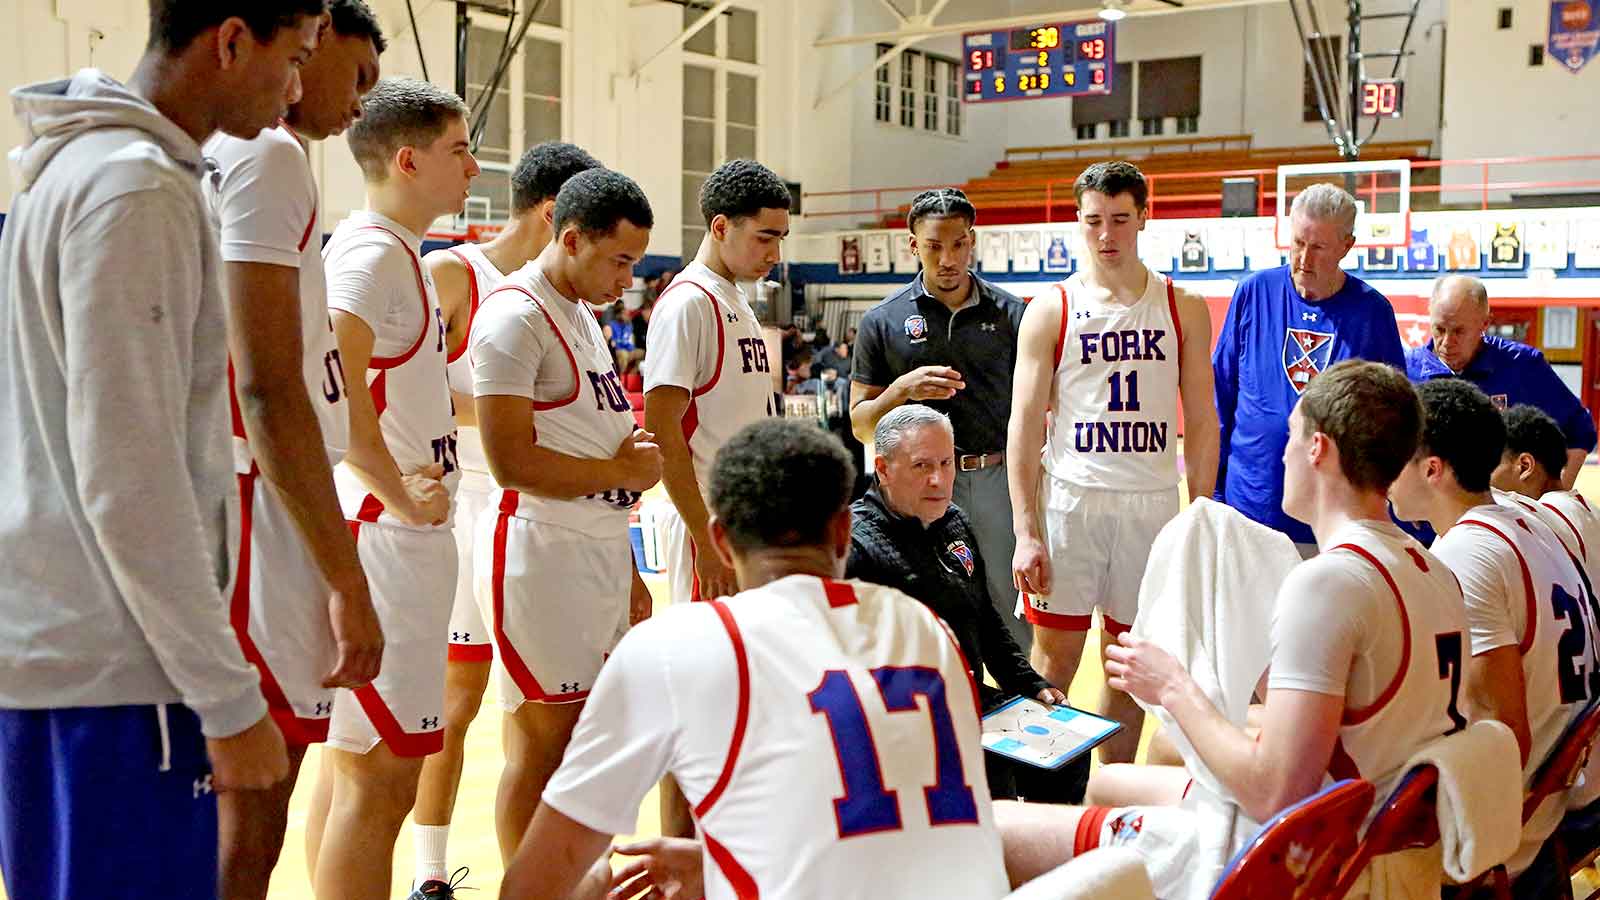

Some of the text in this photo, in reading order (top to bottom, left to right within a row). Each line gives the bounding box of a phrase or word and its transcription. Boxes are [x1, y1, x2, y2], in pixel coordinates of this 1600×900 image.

[971, 50, 993, 70] 51
[1038, 51, 1048, 67] 2
[1081, 39, 1105, 59] 43
[994, 76, 1005, 93] 5
[1094, 69, 1105, 84] 0
[1363, 84, 1396, 114] 30
[737, 337, 770, 373] FOR
[1079, 329, 1166, 365] FORK
[1108, 370, 1140, 411] 11
[1074, 421, 1168, 453] UNION
[1435, 631, 1468, 736] 7
[807, 665, 980, 840] 17
